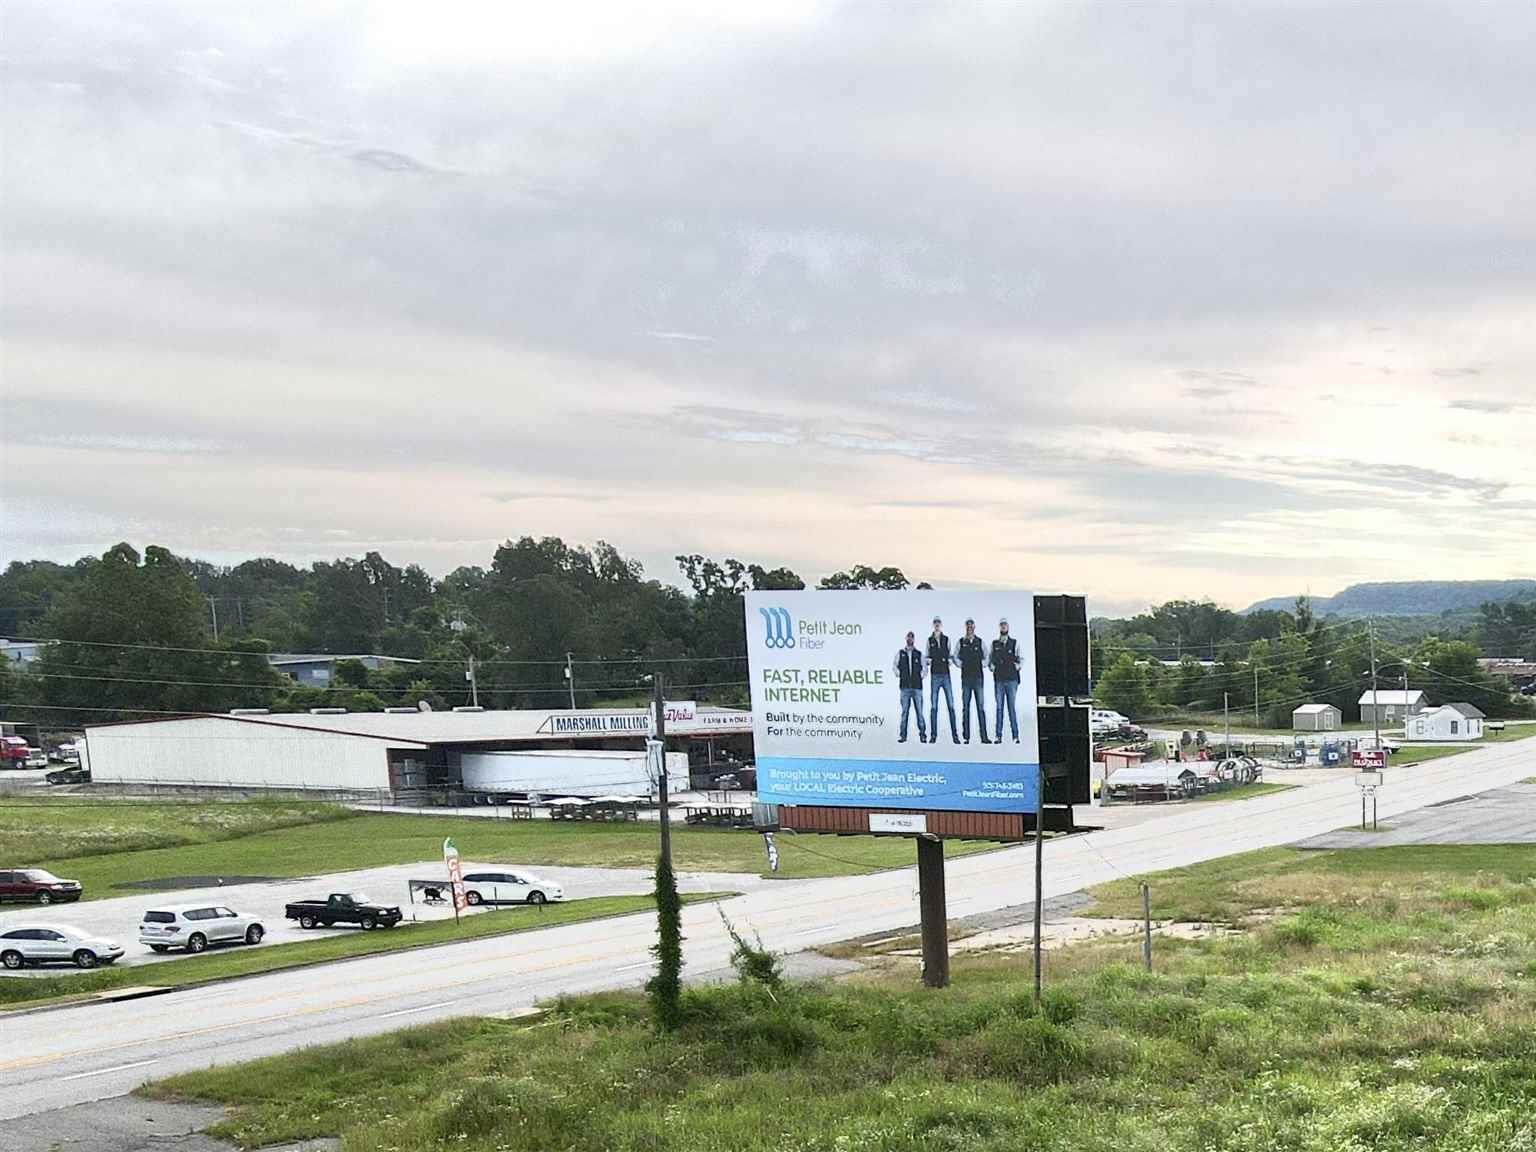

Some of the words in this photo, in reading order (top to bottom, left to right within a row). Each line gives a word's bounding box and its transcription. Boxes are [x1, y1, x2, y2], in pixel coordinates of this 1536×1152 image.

[799, 619, 827, 635] Petit
[829, 620, 862, 635] Jean
[800, 637, 825, 649] Fiber
[763, 669, 804, 685] FAST,
[808, 669, 884, 684] RELIABLE
[765, 687, 840, 702] INTERNET
[556, 717, 607, 732] MARSHALL
[610, 715, 649, 730] MILLING
[766, 712, 790, 722] Built
[792, 713, 805, 724] by
[807, 713, 824, 723] the
[826, 714, 885, 725] community
[767, 726, 783, 736] For
[786, 727, 802, 736] the
[805, 728, 863, 739] community
[769, 769, 809, 780] Brought
[810, 769, 821, 779] to
[822, 772, 842, 782] you
[843, 768, 855, 782] by
[865, 785, 925, 796] Cooperative
[448, 858, 464, 909] CARS
